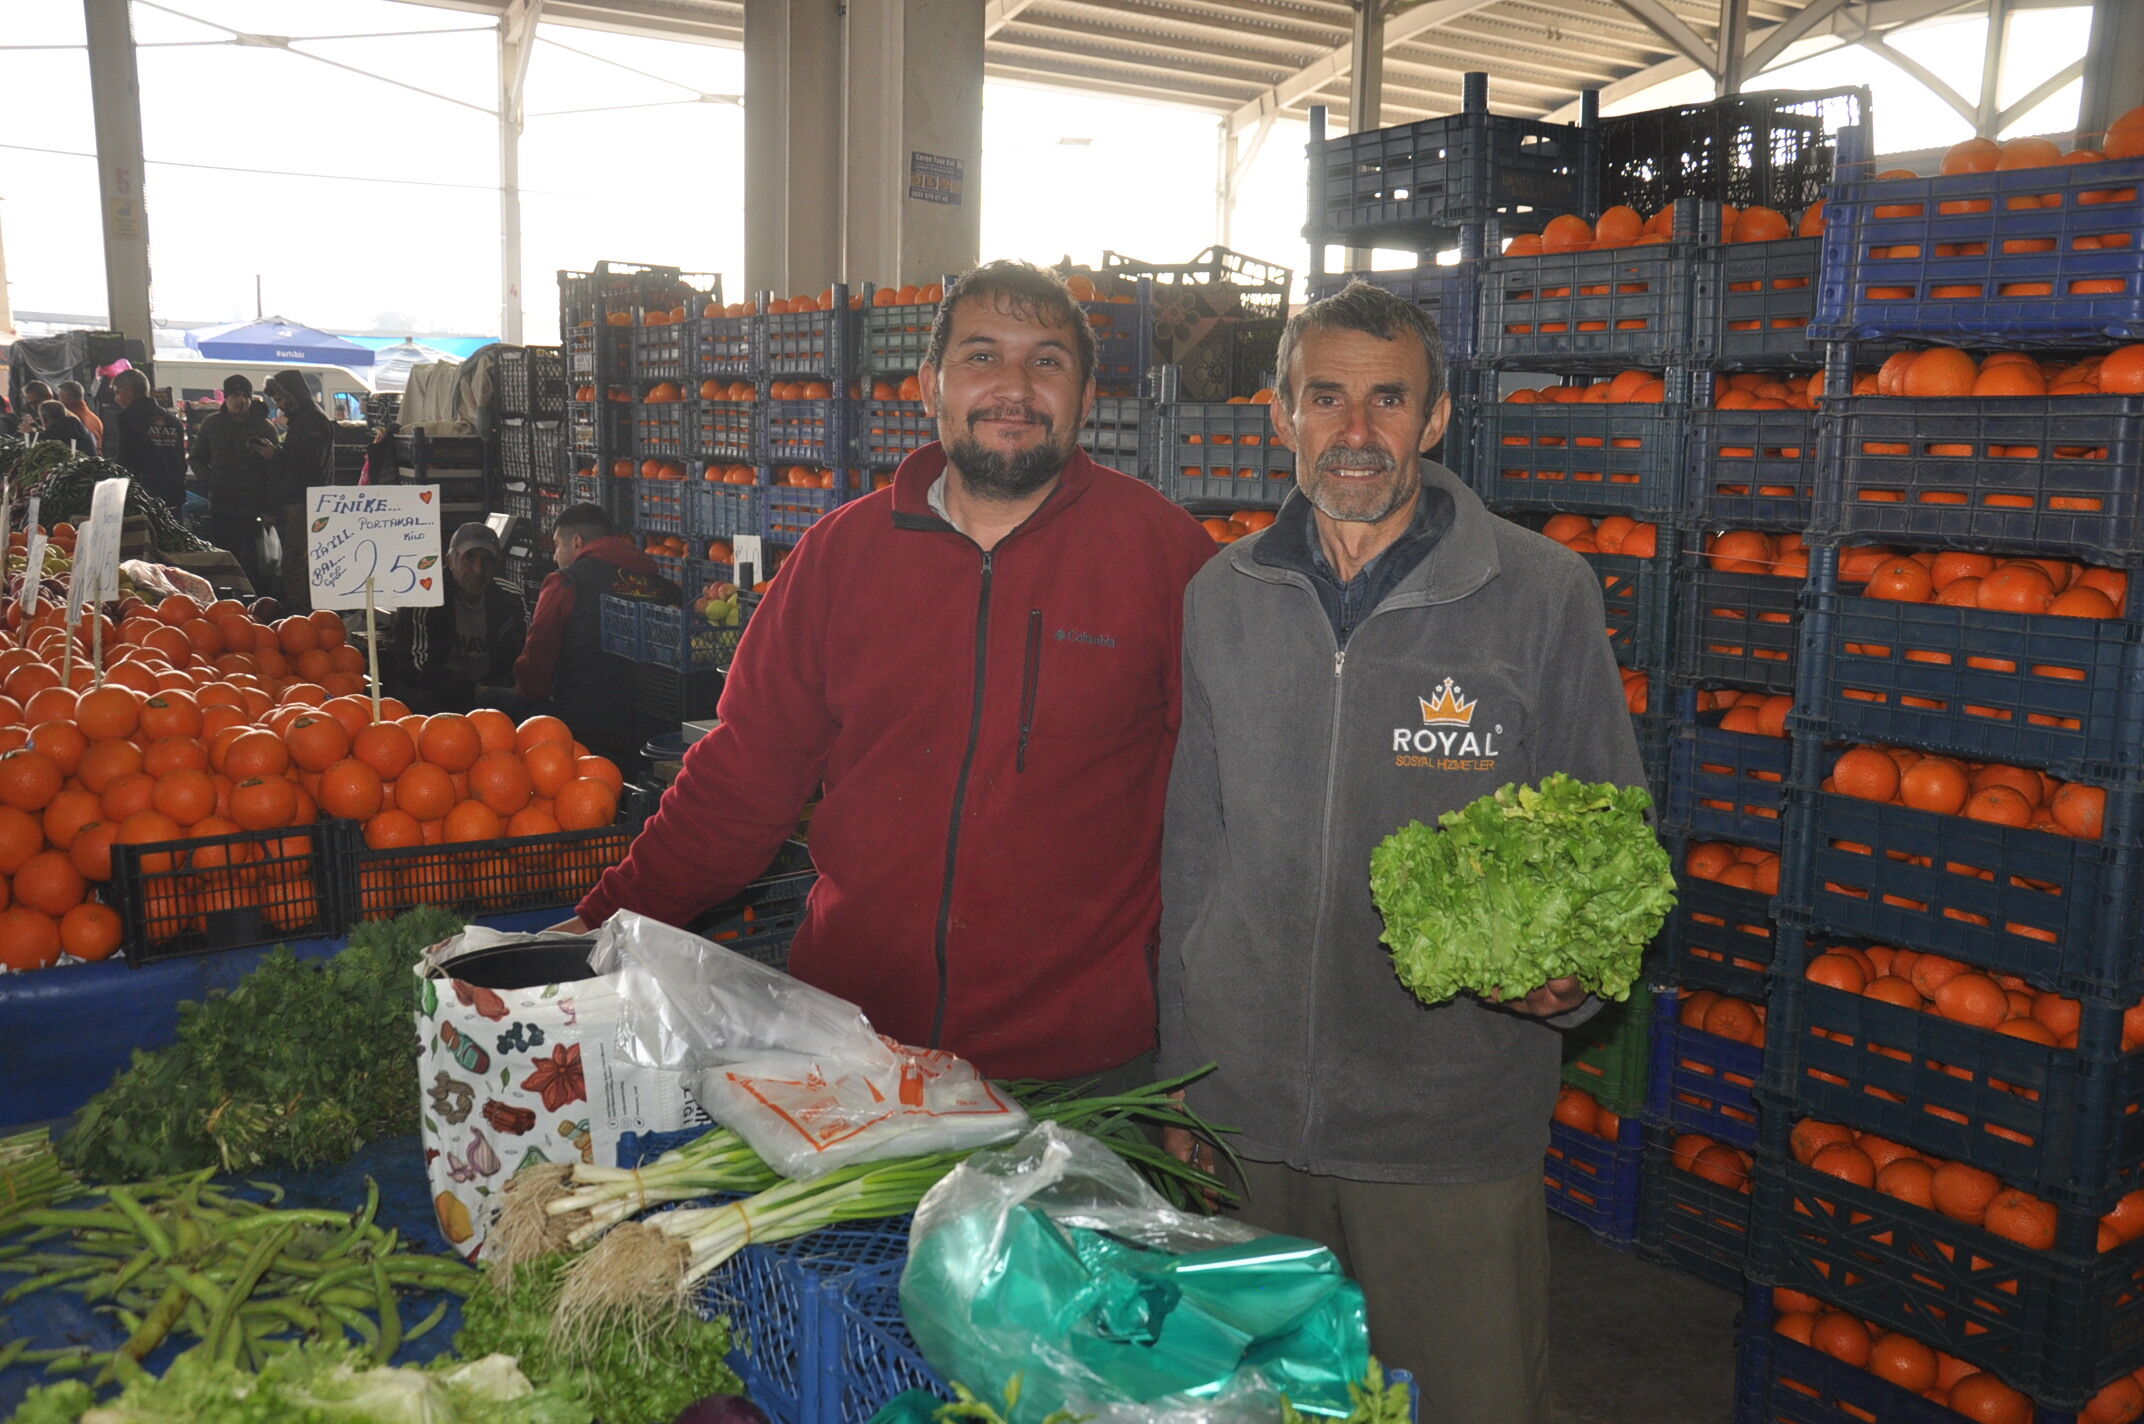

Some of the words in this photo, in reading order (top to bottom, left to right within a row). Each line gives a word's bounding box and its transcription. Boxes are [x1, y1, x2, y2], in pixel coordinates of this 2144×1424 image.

[338, 539, 417, 597] 25
[1067, 630, 1116, 648] Columbia
[1392, 728, 1499, 757] ROYAL
[1396, 755, 1434, 768] SOSYAL
